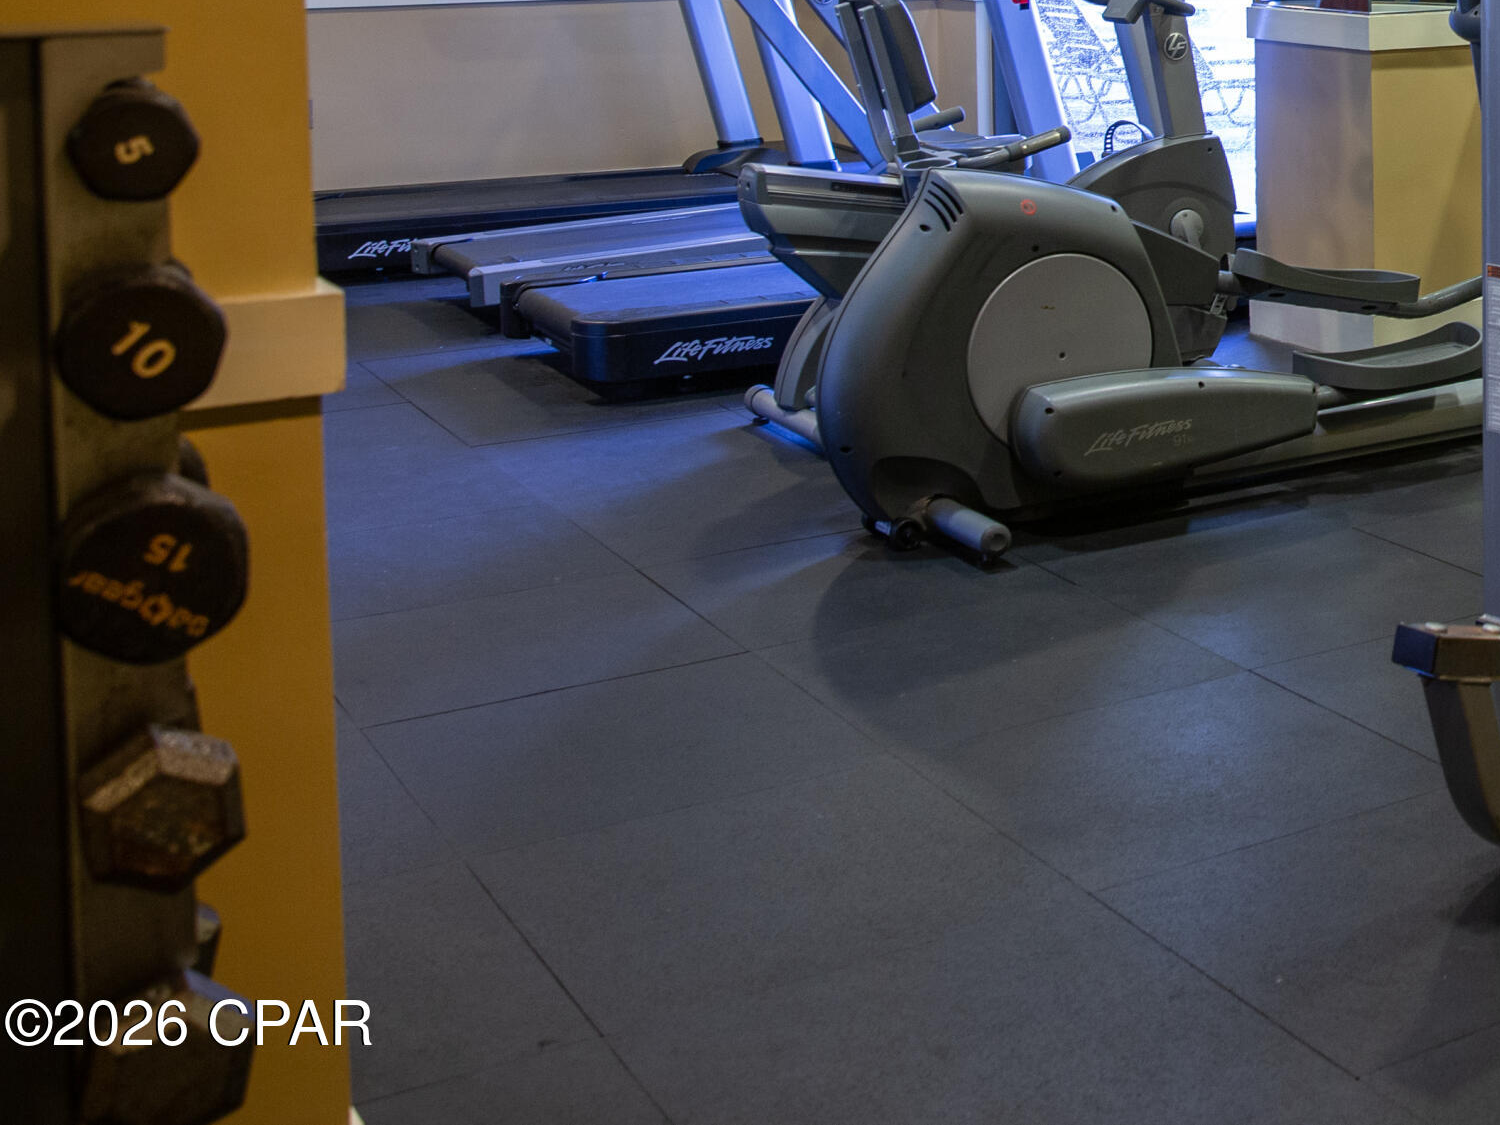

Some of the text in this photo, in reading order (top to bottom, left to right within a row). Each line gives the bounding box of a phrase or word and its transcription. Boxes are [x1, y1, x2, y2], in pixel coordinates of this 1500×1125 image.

[115, 135, 155, 165] 5
[111, 321, 176, 378] 10
[653, 335, 774, 365] LifeFitness
[144, 533, 192, 572] 15
